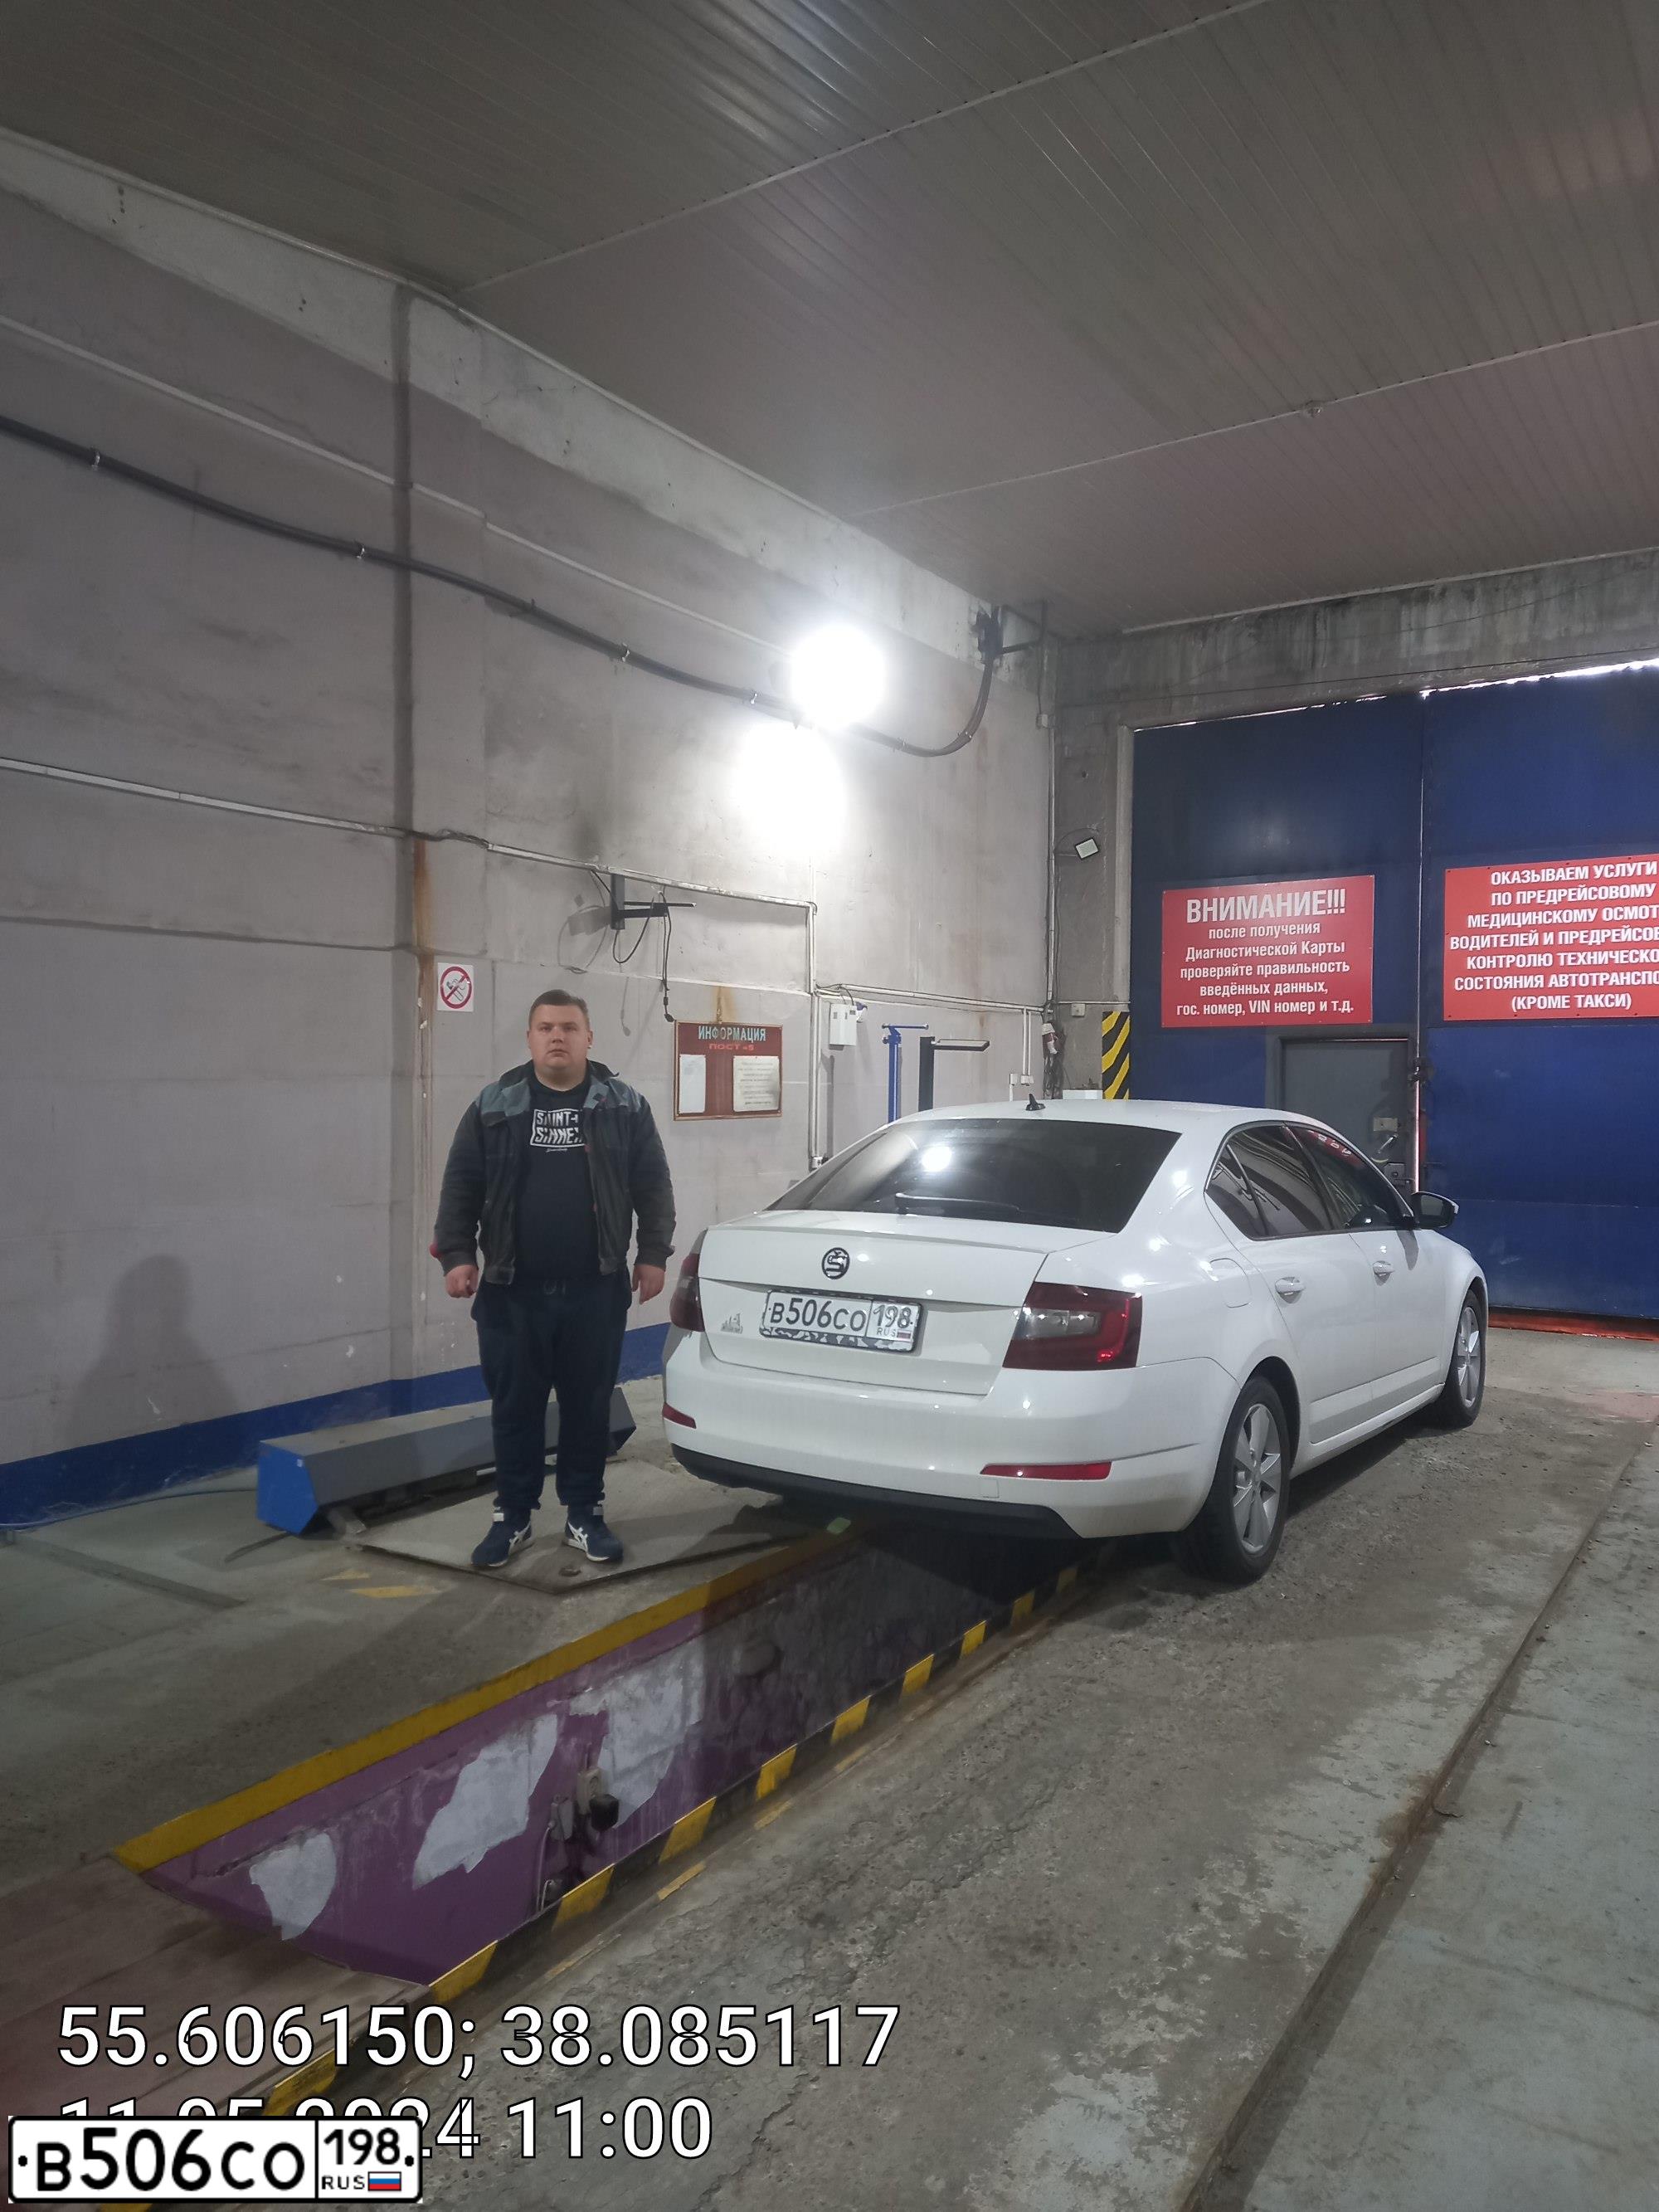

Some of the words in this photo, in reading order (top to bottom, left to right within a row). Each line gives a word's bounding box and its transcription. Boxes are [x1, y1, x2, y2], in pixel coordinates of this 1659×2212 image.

[1491, 865, 1589, 885] ОКАЗЫВАЕМ
[1593, 861, 1658, 879] УСЛУГИ
[1491, 891, 1512, 906] ПО
[1515, 882, 1657, 905] ПРЕДРЕЙСОВОМУ
[1186, 888, 1346, 923] ВНИМАНИЕ!!!
[1467, 908, 1598, 929] МЕДИЦИНСКОМУ
[1209, 925, 1246, 939] после
[1250, 923, 1321, 938] получения
[1450, 929, 1539, 951] ВОДИТЕЛЕЙ
[1543, 931, 1554, 946] И
[1185, 942, 1297, 962] Диагностической
[1301, 941, 1345, 957] Карты
[1467, 953, 1553, 970] КОНТРОЛЮ
[1556, 948, 1659, 967] ТЕХНИЧЕСКО
[1180, 962, 1253, 980] проверяйте
[1257, 961, 1350, 978] правильность
[1199, 982, 1270, 998] введённых
[1274, 981, 1328, 996] данных,
[1454, 975, 1544, 992] СОСТОЯНИЯ
[1176, 1004, 1200, 1016] гос.
[1203, 1002, 1246, 1017] номер,
[1248, 1000, 1271, 1014] VIN
[1274, 1001, 1316, 1016] номер
[1319, 1001, 1328, 1012] и
[1331, 1000, 1354, 1014] т.д.
[1511, 995, 1570, 1013] (КРОМЕ
[1574, 992, 1632, 1011] ТАКСИ)
[698, 1026, 766, 1043] ИНФОРМАЦИЯ
[873, 1304, 912, 1328] 198
[877, 1328, 896, 1337] RUS
